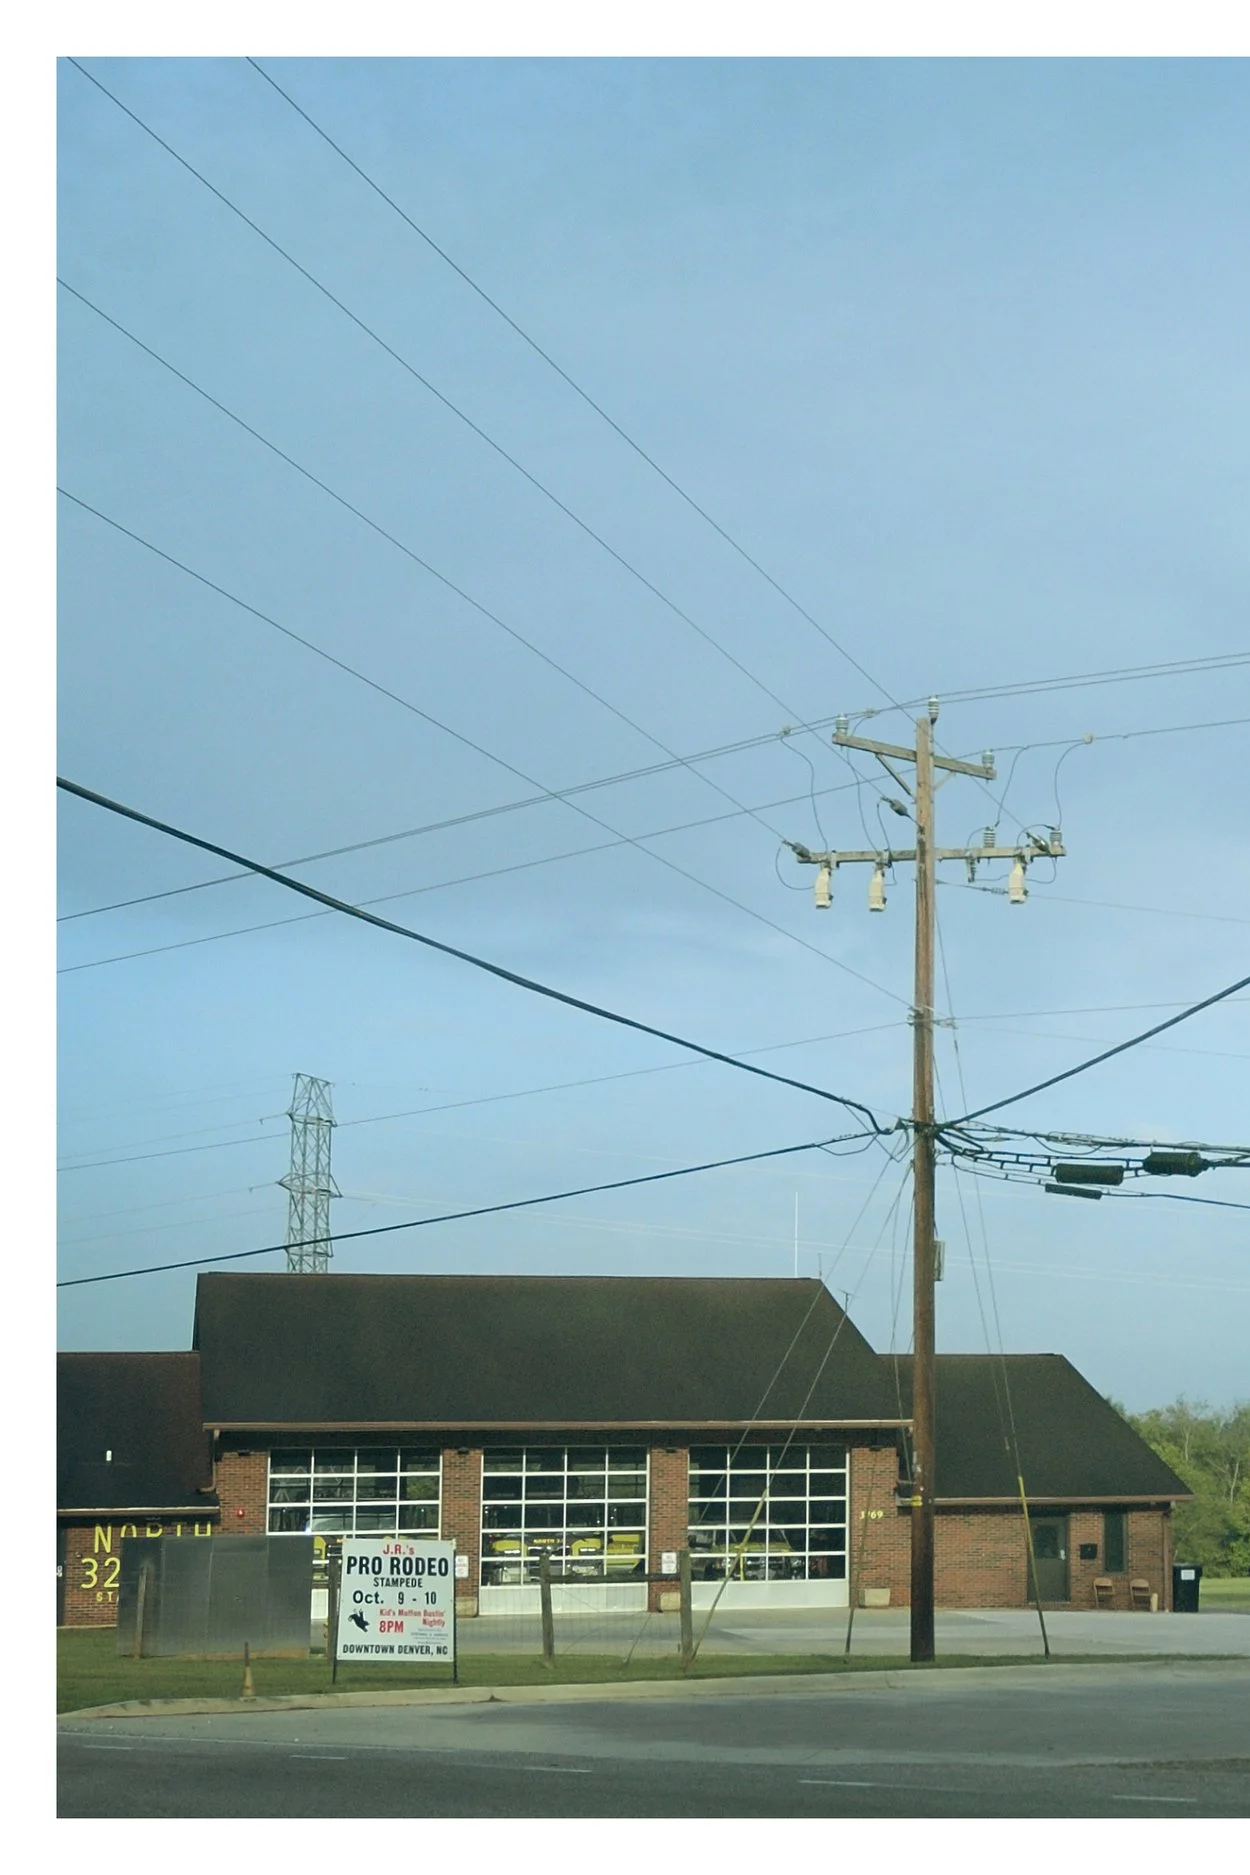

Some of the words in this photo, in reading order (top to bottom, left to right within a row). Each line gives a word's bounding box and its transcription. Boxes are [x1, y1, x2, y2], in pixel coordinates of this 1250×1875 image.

[383, 1544, 415, 1555] J.R.'s
[347, 1556, 382, 1575] PRO
[390, 1557, 449, 1576] RODEO
[373, 1577, 423, 1587] STAMPEDE
[353, 1590, 384, 1604] Oct.
[398, 1592, 405, 1605] 9
[425, 1591, 437, 1604] 10
[379, 1620, 404, 1633] 8PM
[342, 1644, 395, 1654] DOWNTOWN
[398, 1645, 434, 1656] DENVER,
[436, 1646, 449, 1655] NC
